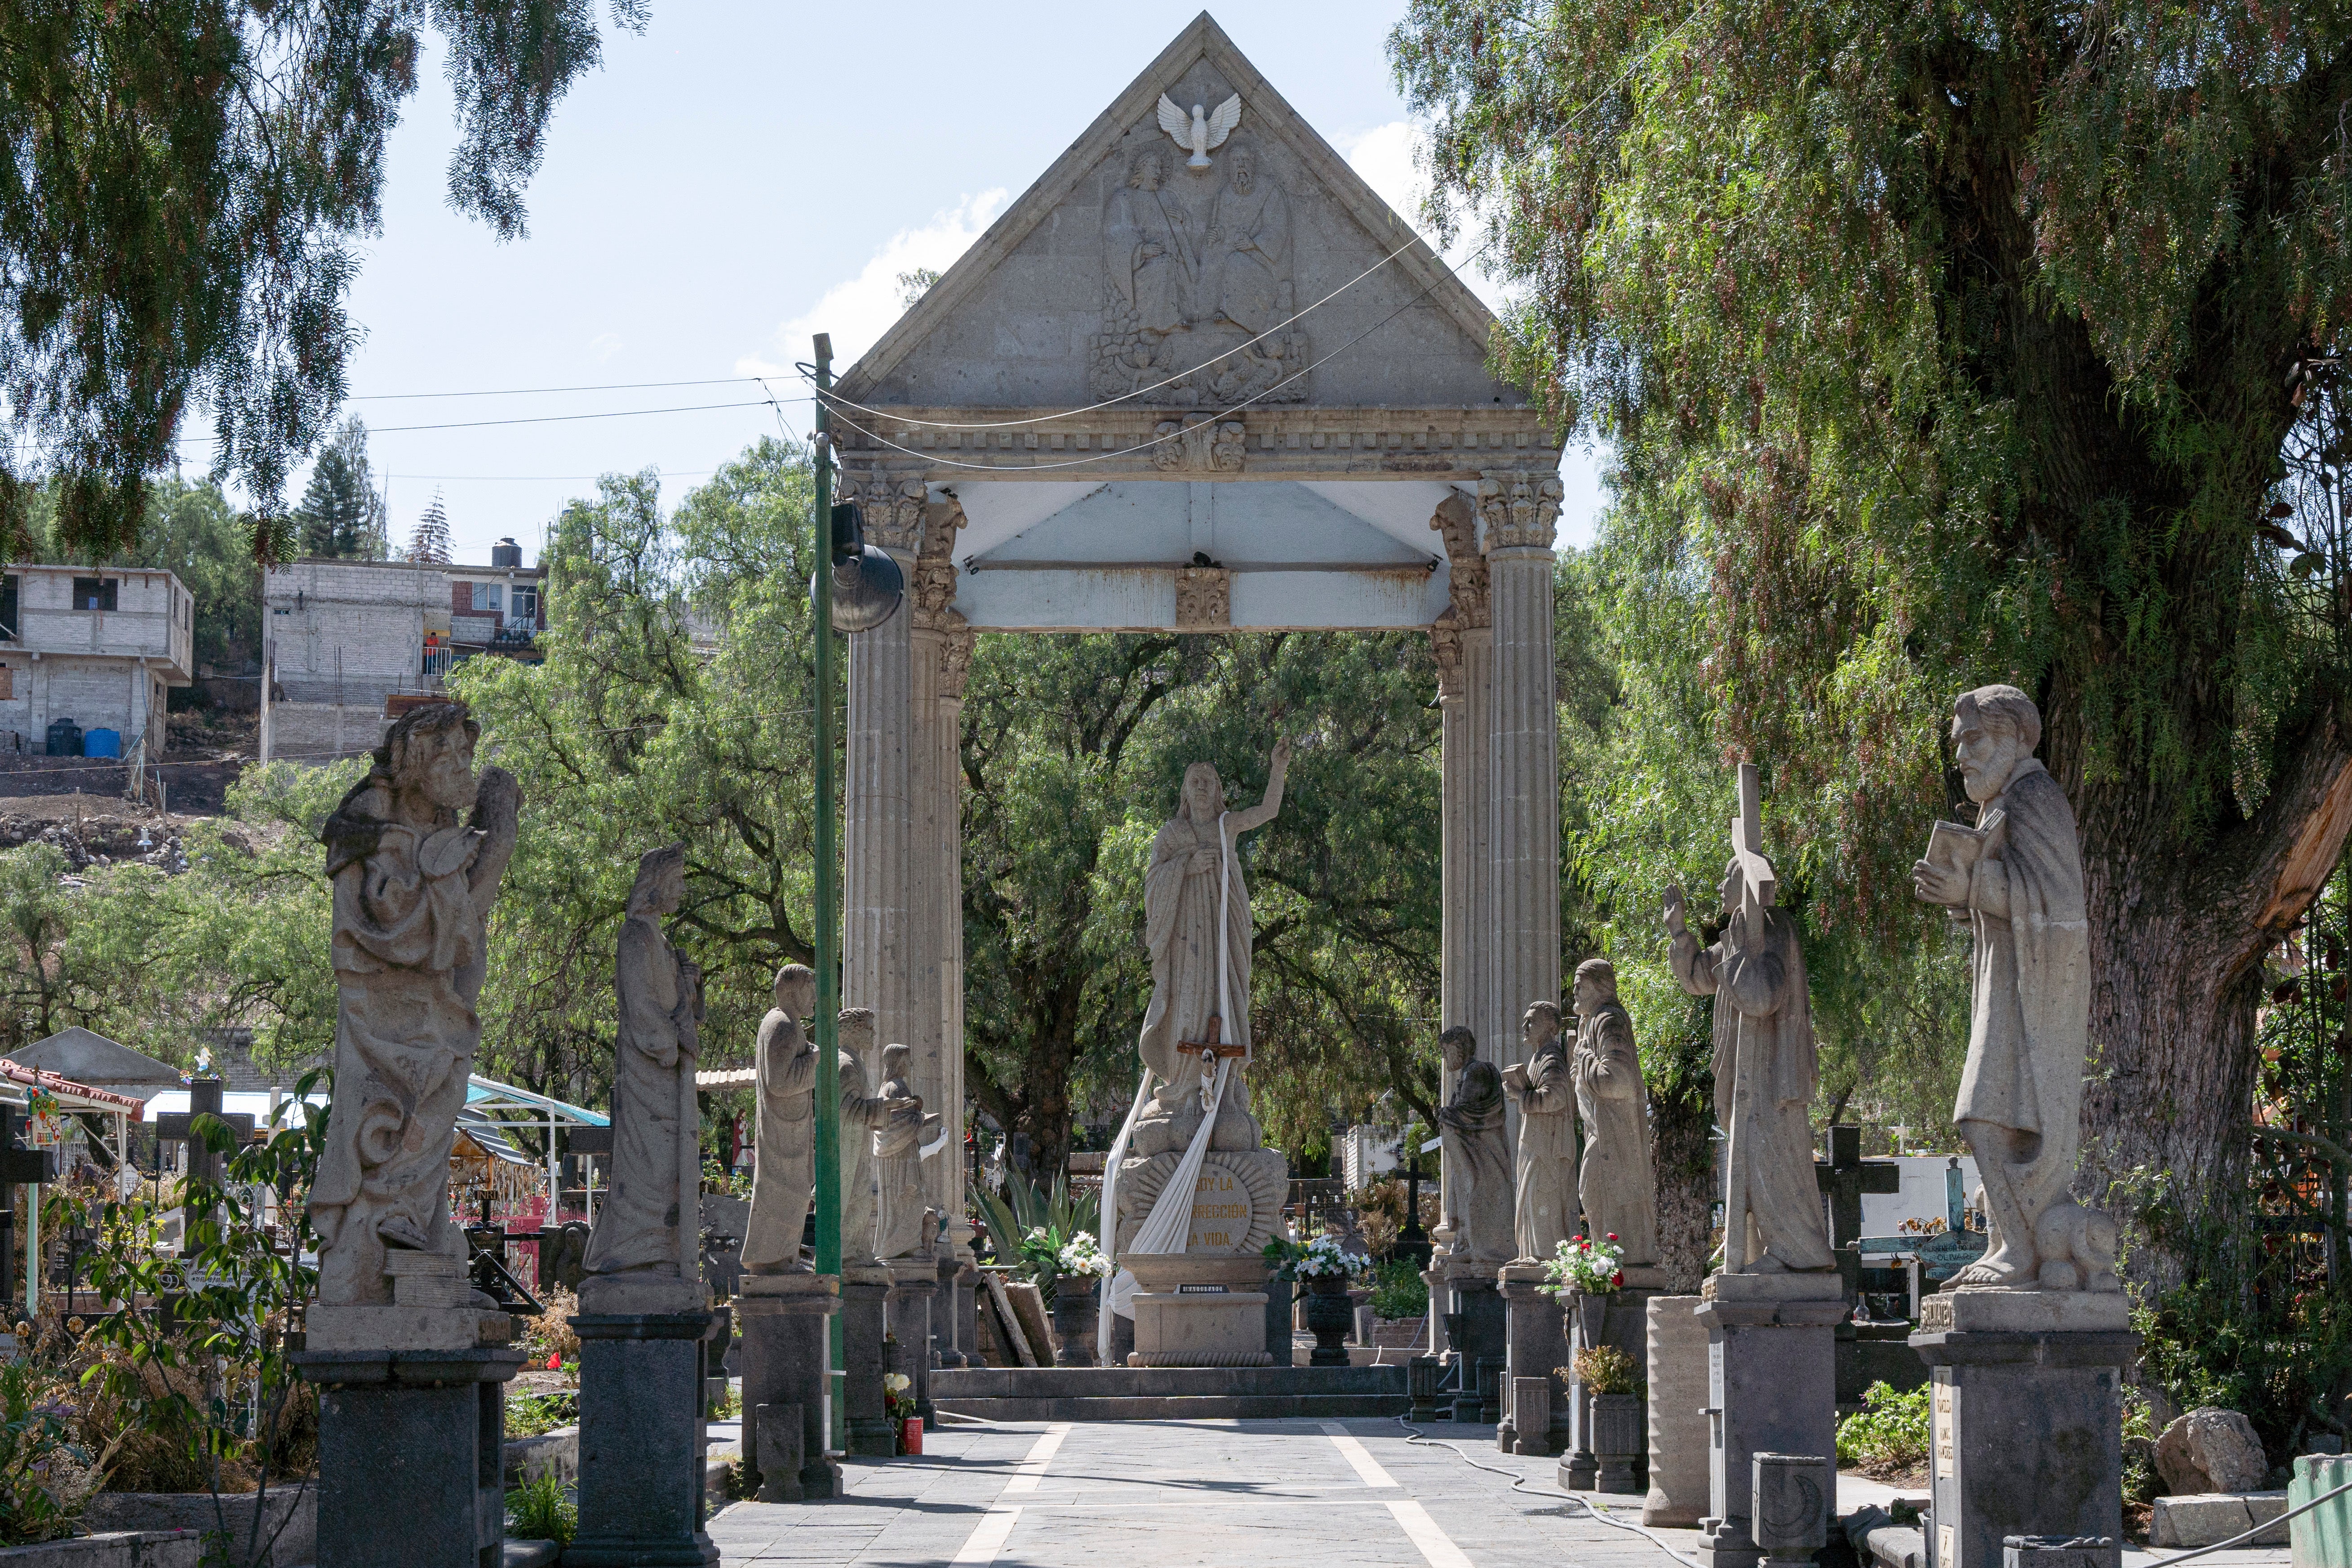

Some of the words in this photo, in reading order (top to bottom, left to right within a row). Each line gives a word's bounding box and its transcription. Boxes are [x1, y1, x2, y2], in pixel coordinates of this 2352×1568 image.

[1220, 1177, 1234, 1191] LA
[477, 1191, 497, 1200] INRI
[1204, 1232, 1233, 1246] VIDA.
